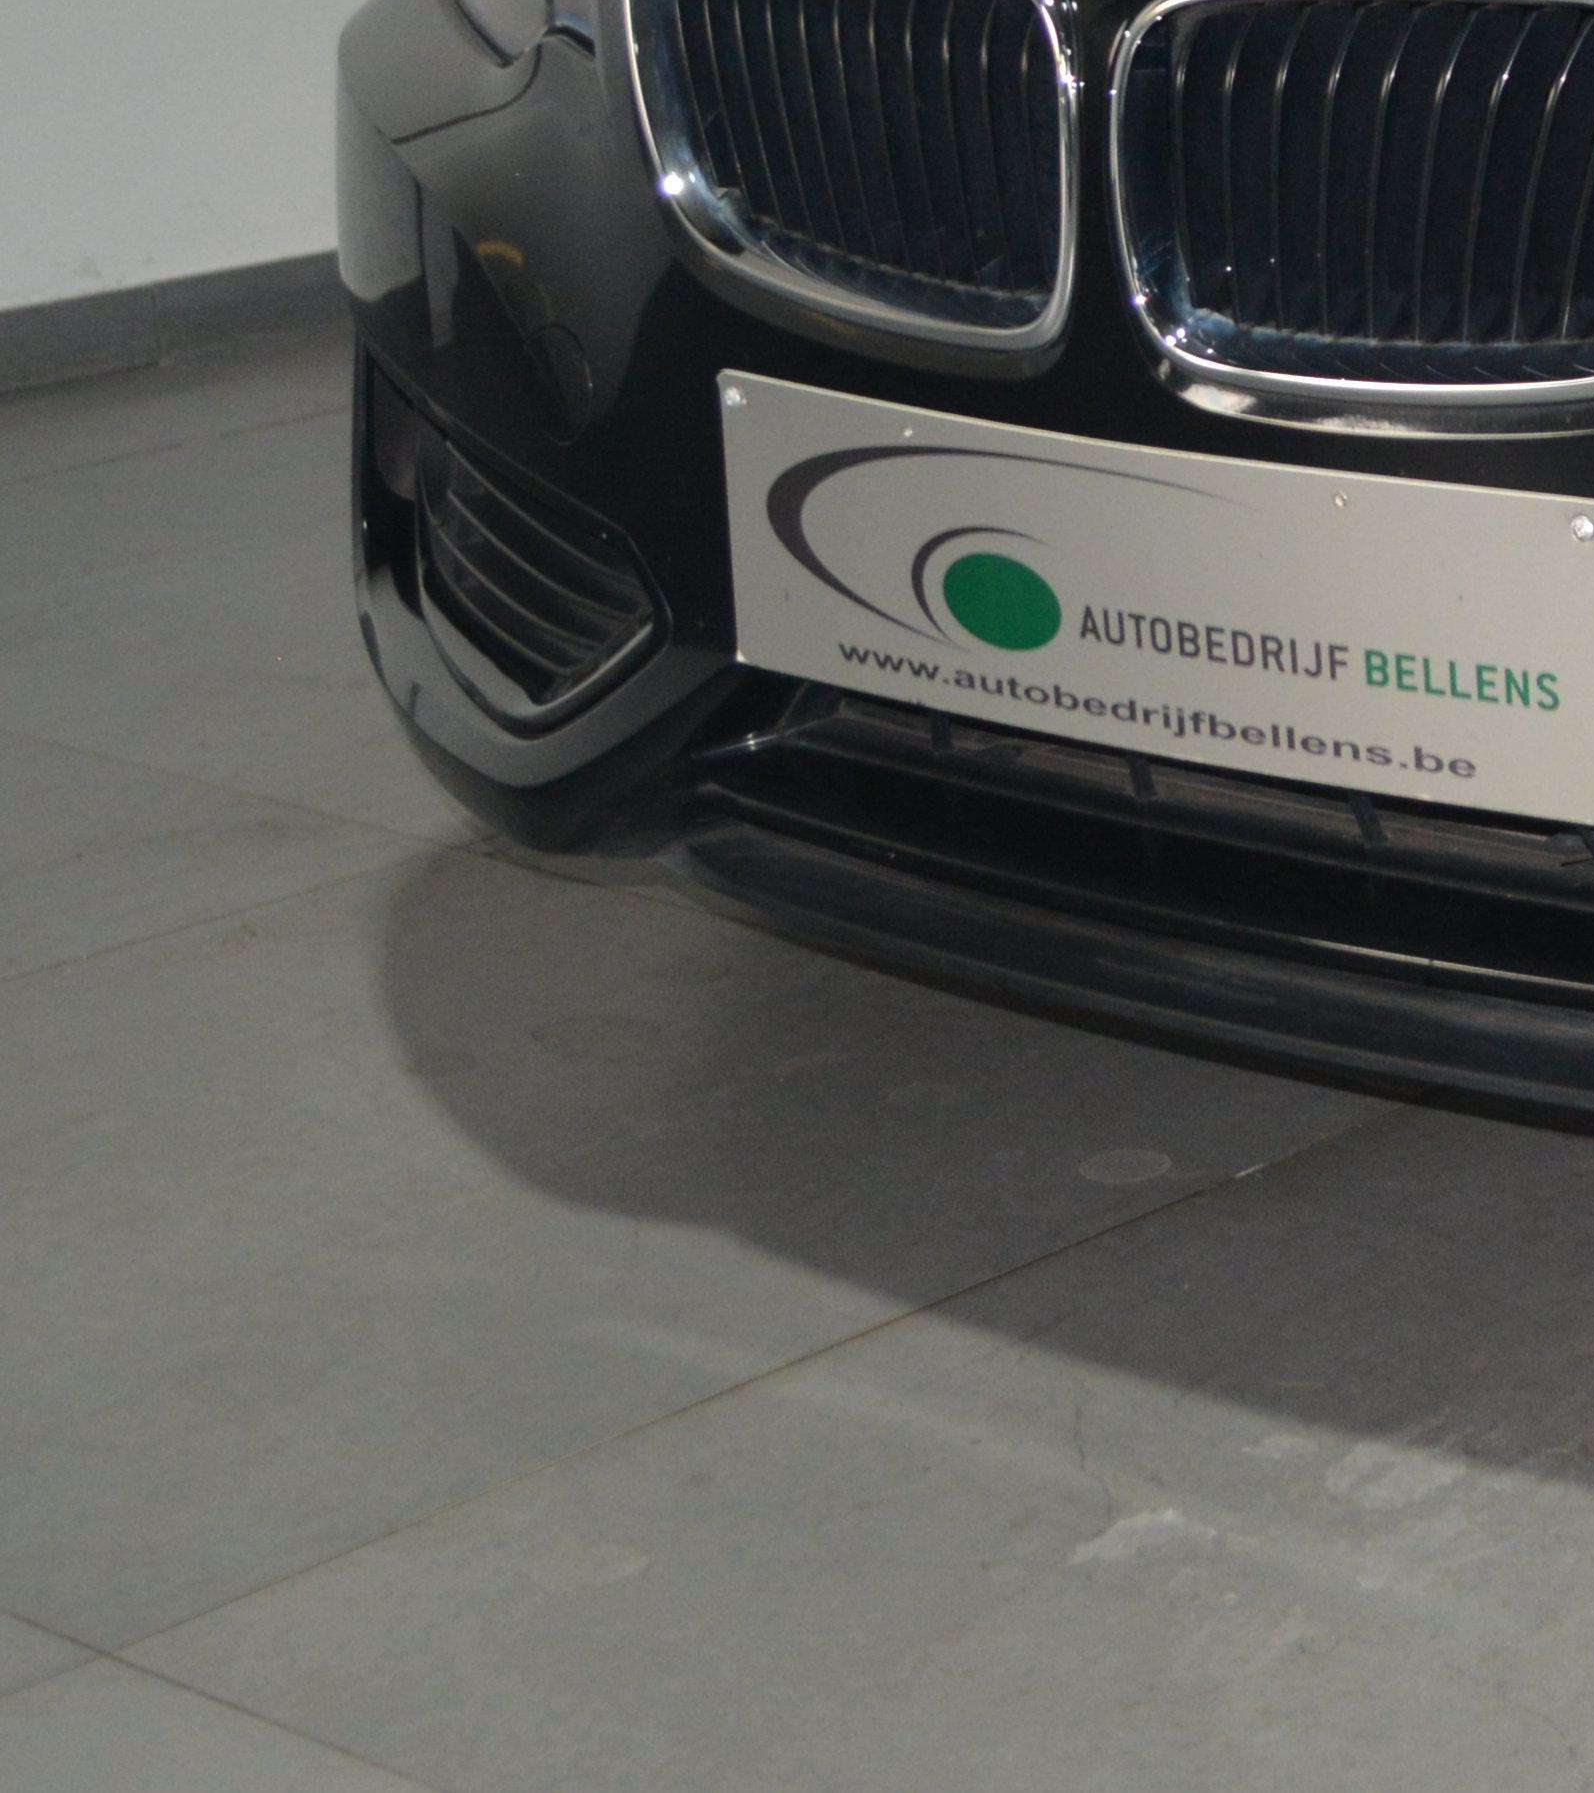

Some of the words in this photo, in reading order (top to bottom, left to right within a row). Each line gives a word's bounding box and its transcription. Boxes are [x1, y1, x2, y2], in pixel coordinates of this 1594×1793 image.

[837, 642, 1478, 780] www.autobedrijfbellens.be
[1079, 605, 1349, 681] AUTOBEDRIJF
[1363, 648, 1561, 712] BELLENS
